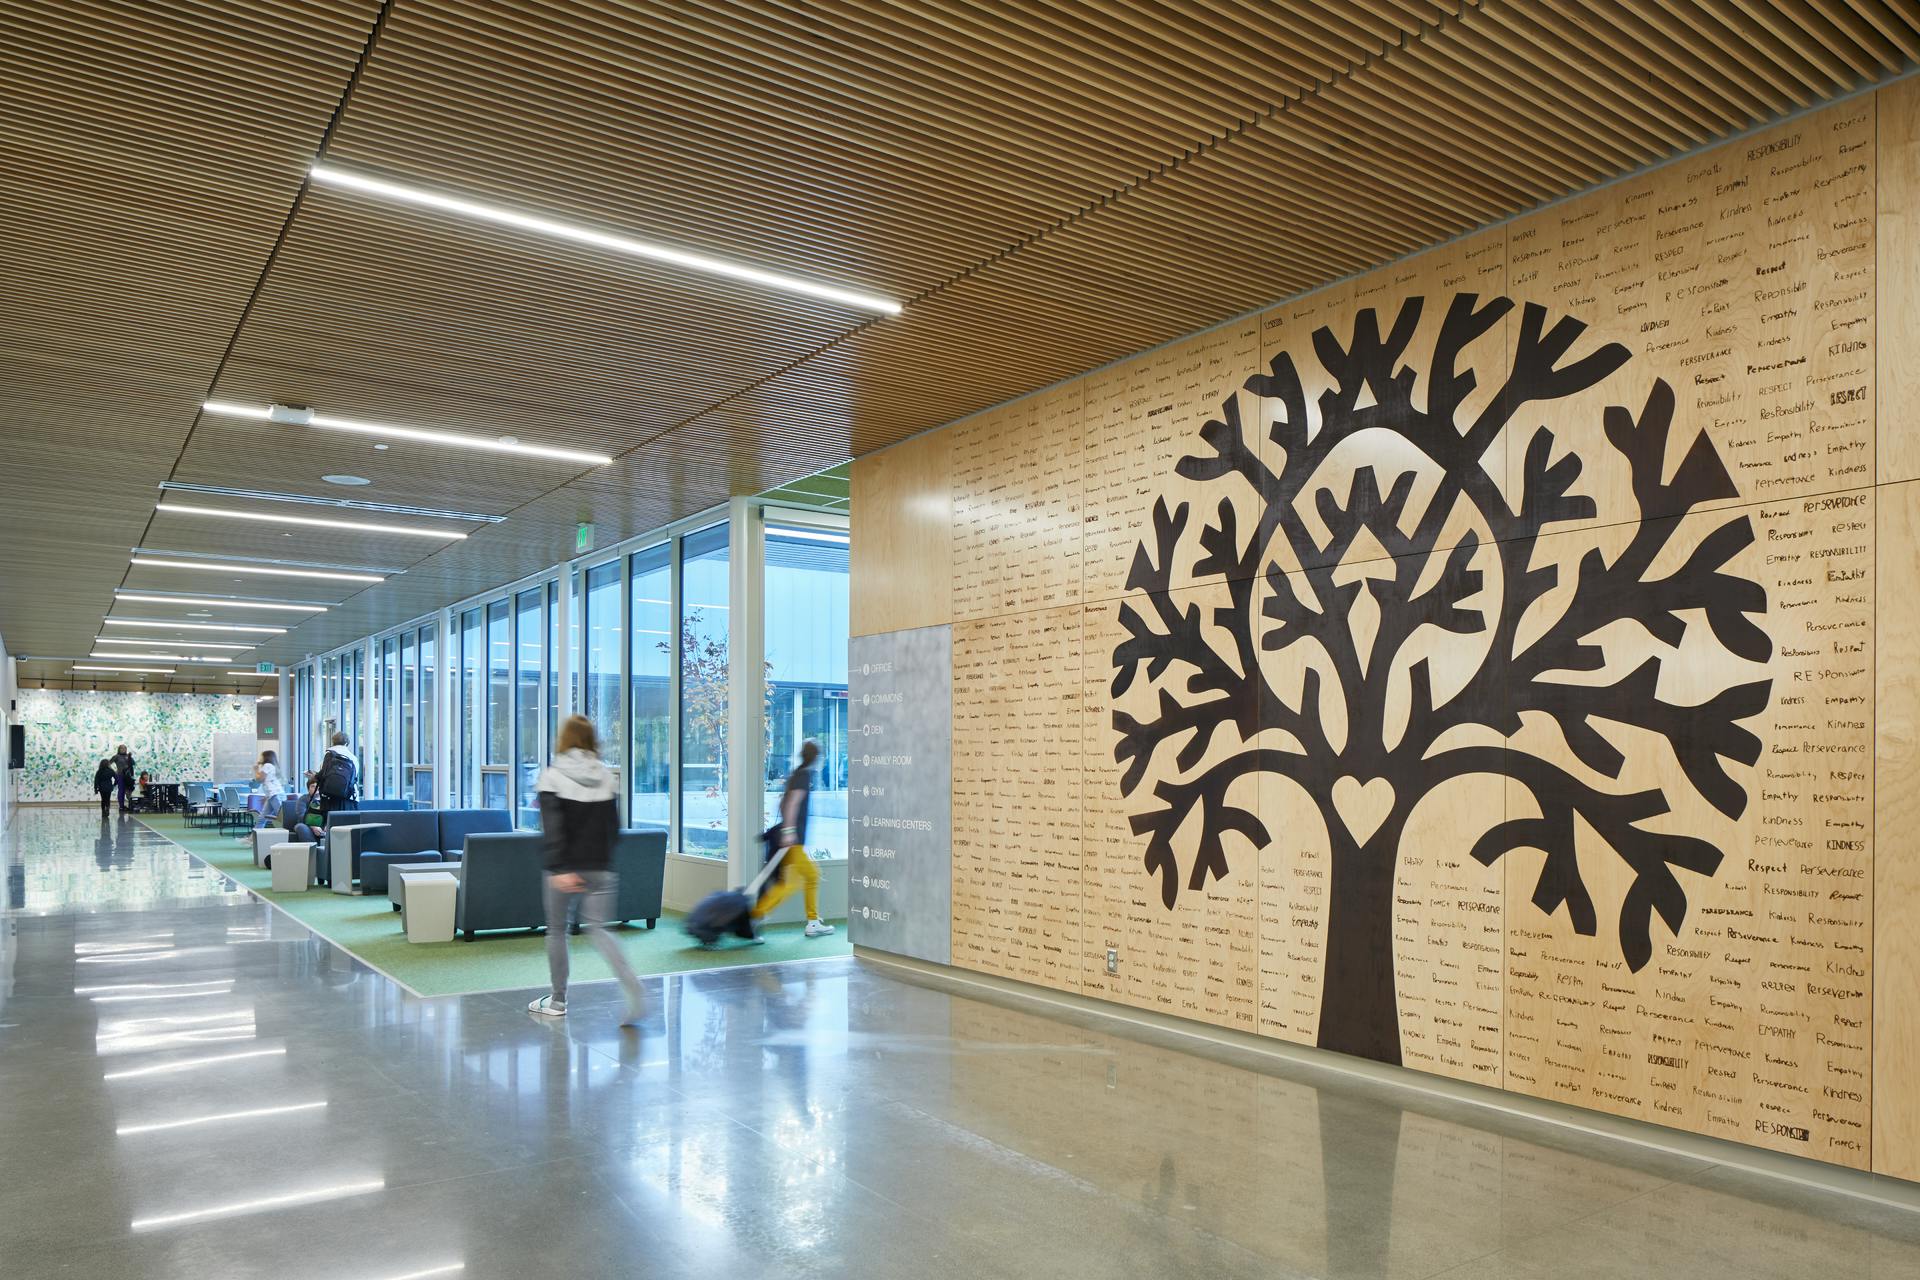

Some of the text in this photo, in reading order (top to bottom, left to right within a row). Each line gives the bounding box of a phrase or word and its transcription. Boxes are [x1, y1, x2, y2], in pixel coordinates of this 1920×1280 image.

[1747, 133, 1802, 162] RESPONSIBILITY
[1656, 221, 1704, 241] Perseverance
[1720, 203, 1752, 221] Kindness
[1817, 242, 1867, 260] Perseverance
[1757, 335, 1791, 348] Kindness
[871, 662, 892, 673] OFFICE
[871, 693, 903, 704] COMMONS
[871, 725, 884, 735] DEN
[1803, 741, 1866, 753] Perseverance
[871, 756, 912, 765] FAMILY ROOM
[871, 787, 884, 796] GYM
[1762, 789, 1799, 802] Empathy
[871, 818, 932, 831] LEARNING CENTERS
[1826, 839, 1865, 852] KINDNESS
[871, 848, 896, 859] LIBRARY
[1748, 858, 1864, 879] Respect Perseverance
[871, 879, 890, 889] MUSIC
[871, 909, 891, 921] TOILET
[1541, 950, 1585, 966] Perseverance
[1544, 1056, 1585, 1073] Perseverance
[1765, 1053, 1798, 1068] Kindness
[1752, 1072, 1808, 1094] Perseverance
[1592, 1087, 1642, 1106] Perseverance
[1654, 1099, 1683, 1115] Kindness
